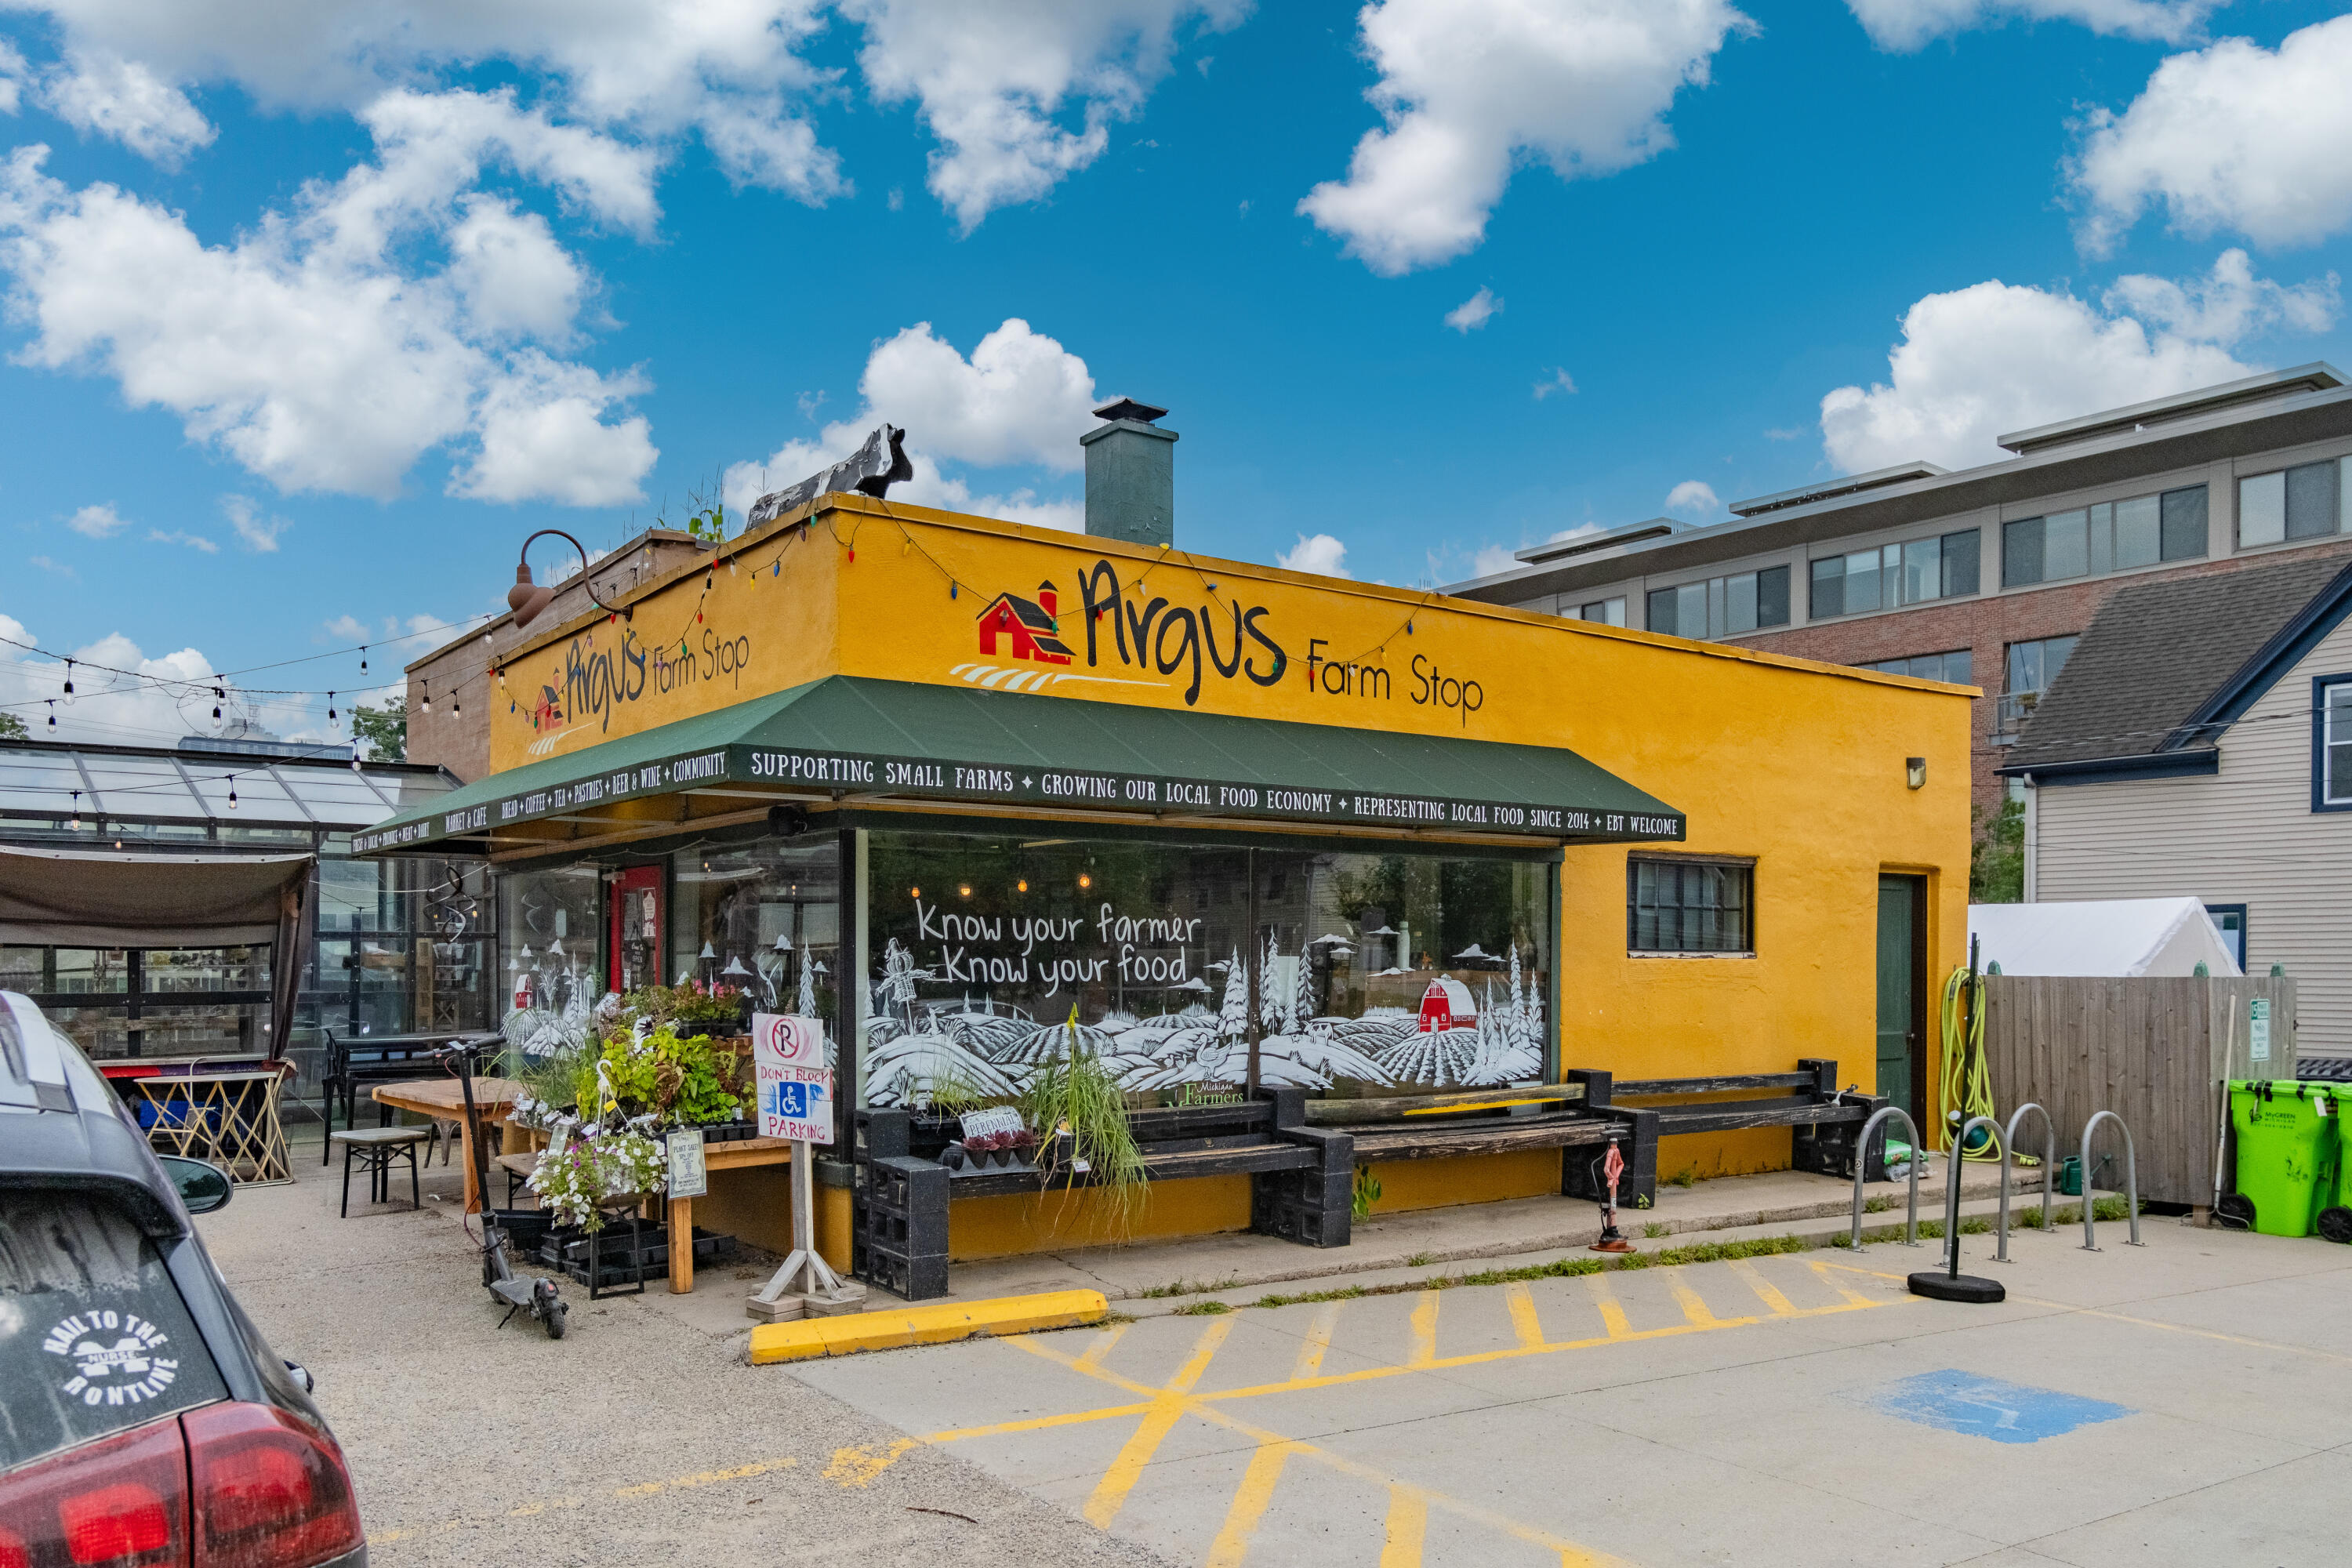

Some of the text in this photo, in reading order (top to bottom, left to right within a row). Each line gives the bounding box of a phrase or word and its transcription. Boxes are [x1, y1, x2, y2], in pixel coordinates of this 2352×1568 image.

[1078, 559, 1287, 706] Argus
[566, 630, 646, 734] Argus
[652, 628, 750, 695] Farm Stop
[1307, 639, 1483, 728] Farm Stop
[445, 811, 466, 833] MARKET
[467, 813, 471, 828] &
[474, 807, 487, 827] CAFE
[502, 800, 518, 819] BREAD
[525, 793, 546, 815] COFFEE
[554, 788, 566, 808] TEA
[574, 779, 603, 804] PASTRIES
[612, 773, 629, 795] BEER
[632, 773, 637, 791] &
[641, 765, 661, 789] WINE
[673, 751, 726, 782] COMMUNITY
[750, 752, 1678, 835] SUPPORTING SMALL FARMS GROWING OUR LOCAL FOOD ECONOMY REPRESENTING LOCAL FOOD SINCE 2014 EBT WELCOME
[916, 898, 1202, 956] Know your farmer
[943, 943, 1187, 998] Know your food
[779, 1024, 792, 1051] P
[760, 1065, 829, 1084] DON'T BLOCK
[1183, 1083, 1243, 1106] Farmers
[1196, 1082, 1234, 1094] Michigan
[768, 1116, 826, 1140] PARKING
[969, 1113, 1016, 1136] PERENNIAL
[43, 1310, 169, 1355] HAIL TO THE
[88, 1350, 137, 1363] NURSE
